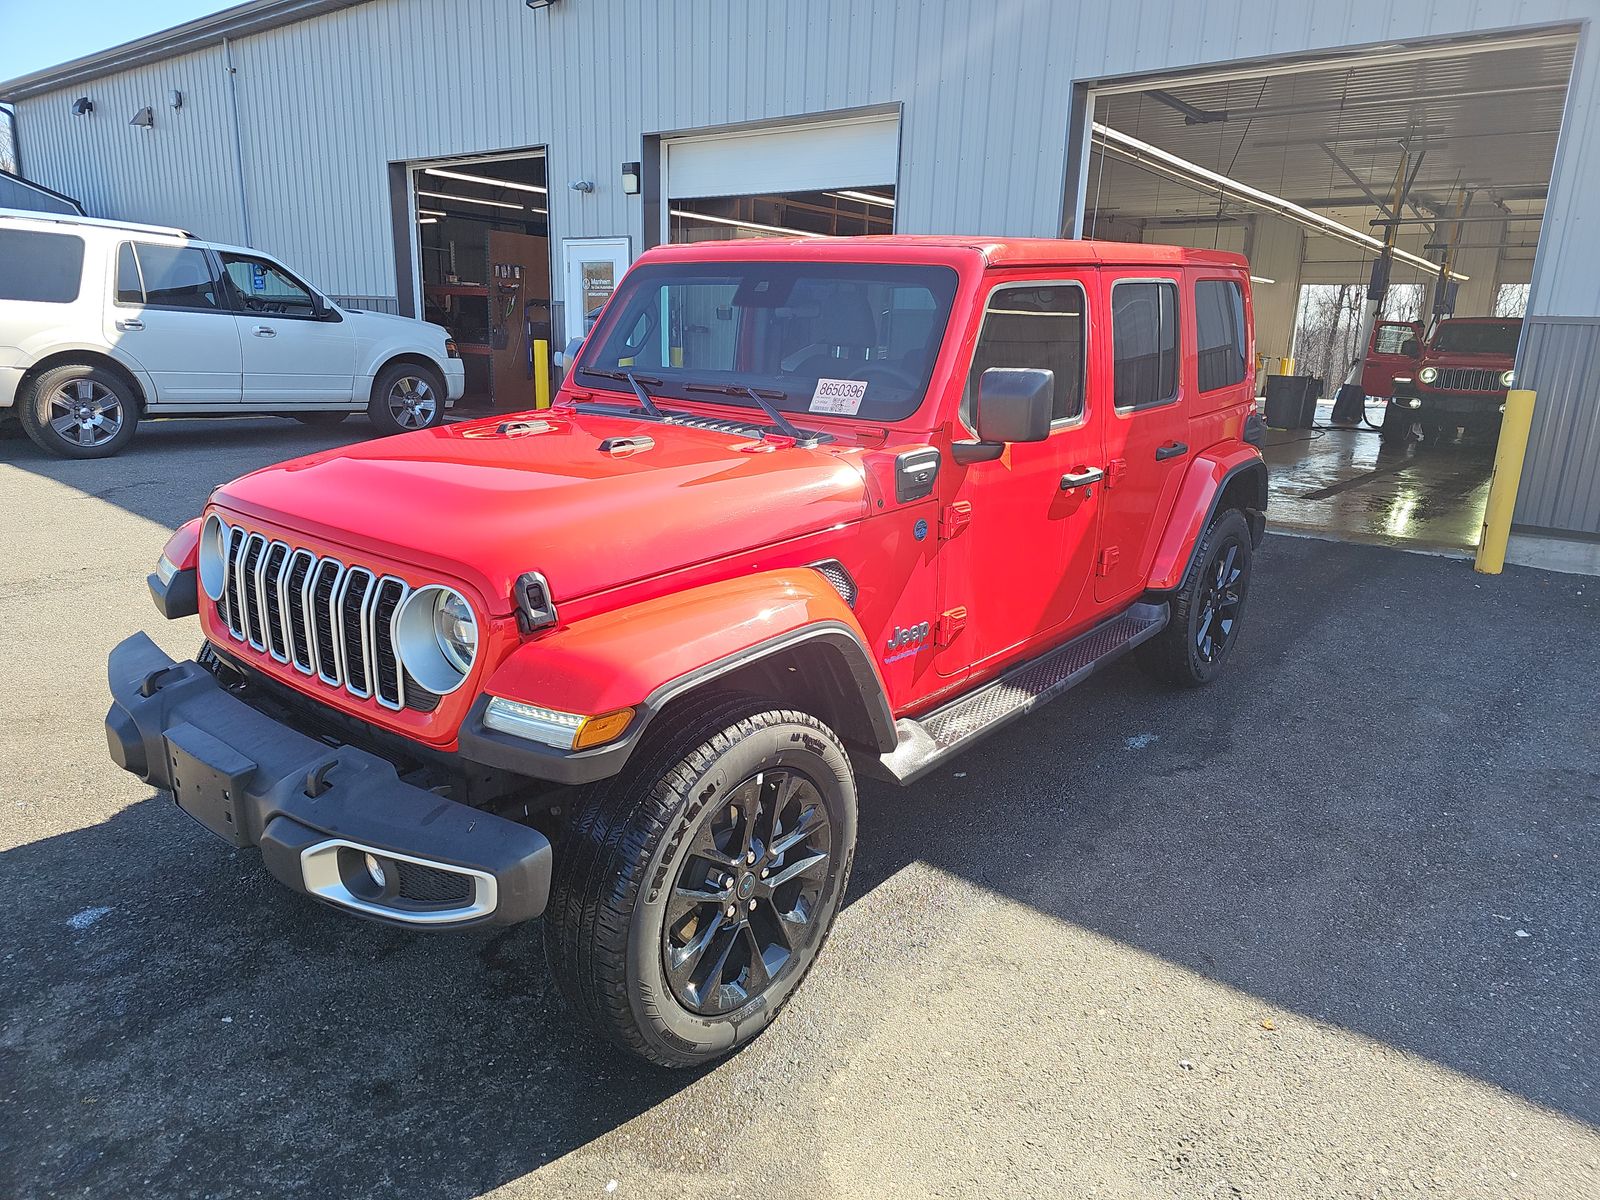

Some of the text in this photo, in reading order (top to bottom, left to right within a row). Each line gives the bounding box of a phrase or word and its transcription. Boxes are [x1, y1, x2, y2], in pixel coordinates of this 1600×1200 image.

[820, 382, 864, 398] 8650396
[887, 621, 929, 650] Jeep
[652, 783, 717, 888] NEXEN
